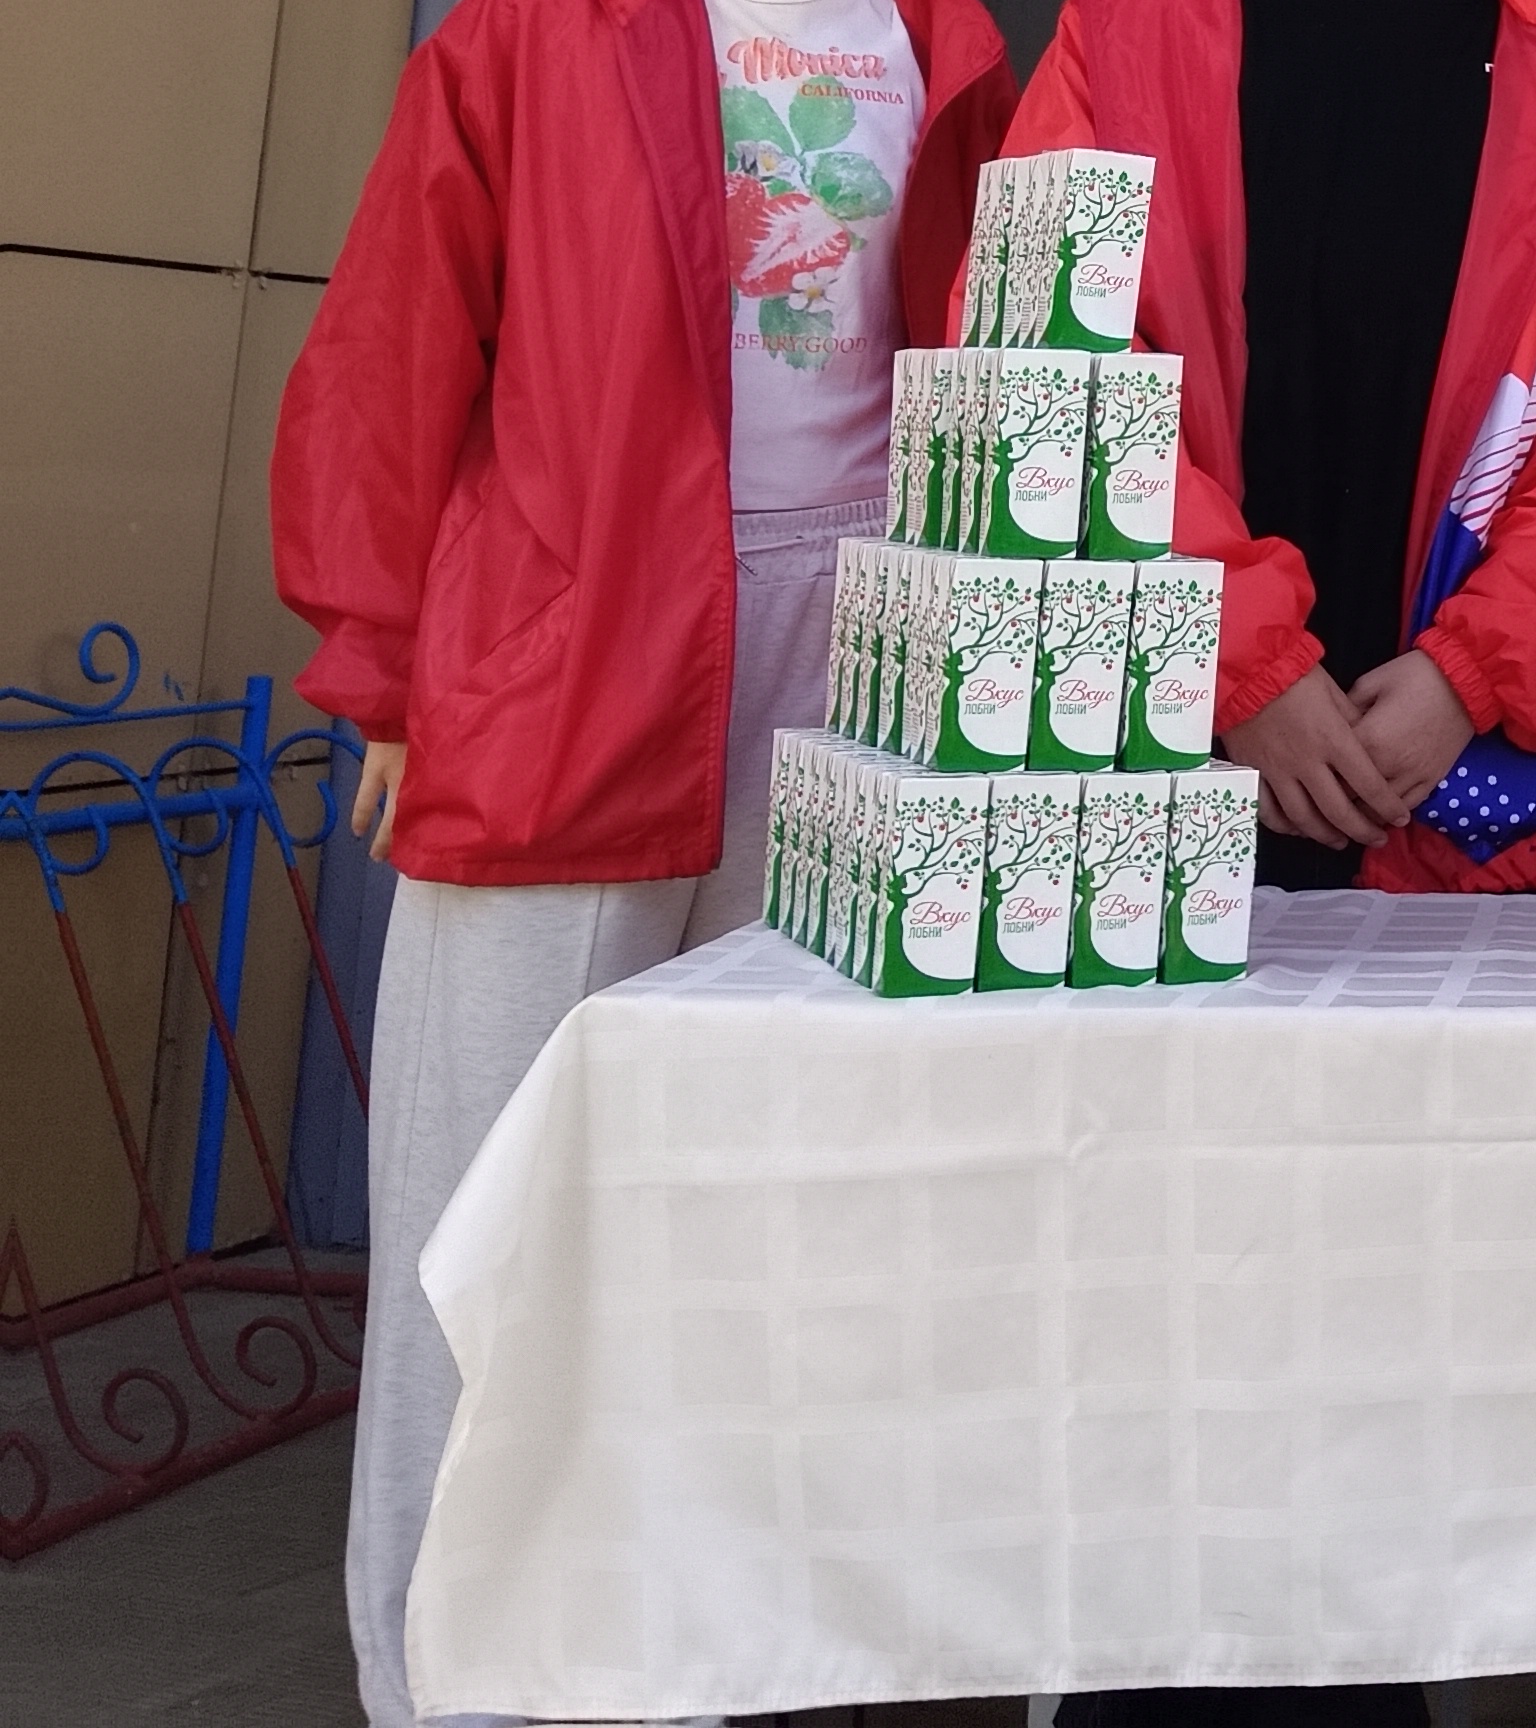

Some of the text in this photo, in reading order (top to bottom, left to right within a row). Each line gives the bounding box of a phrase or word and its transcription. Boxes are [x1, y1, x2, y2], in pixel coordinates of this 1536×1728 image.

[727, 36, 888, 84] Monica
[801, 83, 904, 105] CALIFORNIA
[1080, 265, 1132, 293] Вкус
[1076, 286, 1106, 297] ЛОБНИ
[734, 333, 868, 355] BERRY GOOD
[1019, 467, 1075, 501] Вкус
[1113, 470, 1169, 502] Вкус
[1015, 490, 1047, 501] ЛОБНИ
[1113, 493, 1142, 503] ЛОБНИ
[965, 679, 1024, 711] Вкус
[1056, 680, 1114, 710] Вкус
[1152, 680, 1209, 709] Вкус
[964, 703, 995, 714] ЛОБНИ
[1055, 704, 1086, 714] ЛОБНИ
[1152, 703, 1182, 714] ЛОБНИ
[1004, 897, 1062, 927] Вкус
[1098, 894, 1154, 924] Вкус
[1188, 890, 1243, 920] Вкус
[909, 901, 971, 934] Вкус
[1003, 922, 1034, 933] ЛОБНИ
[1097, 919, 1126, 930] ЛОБНИ
[1187, 914, 1217, 925] ЛОБНИ
[909, 927, 942, 938] ЛОБНИ
